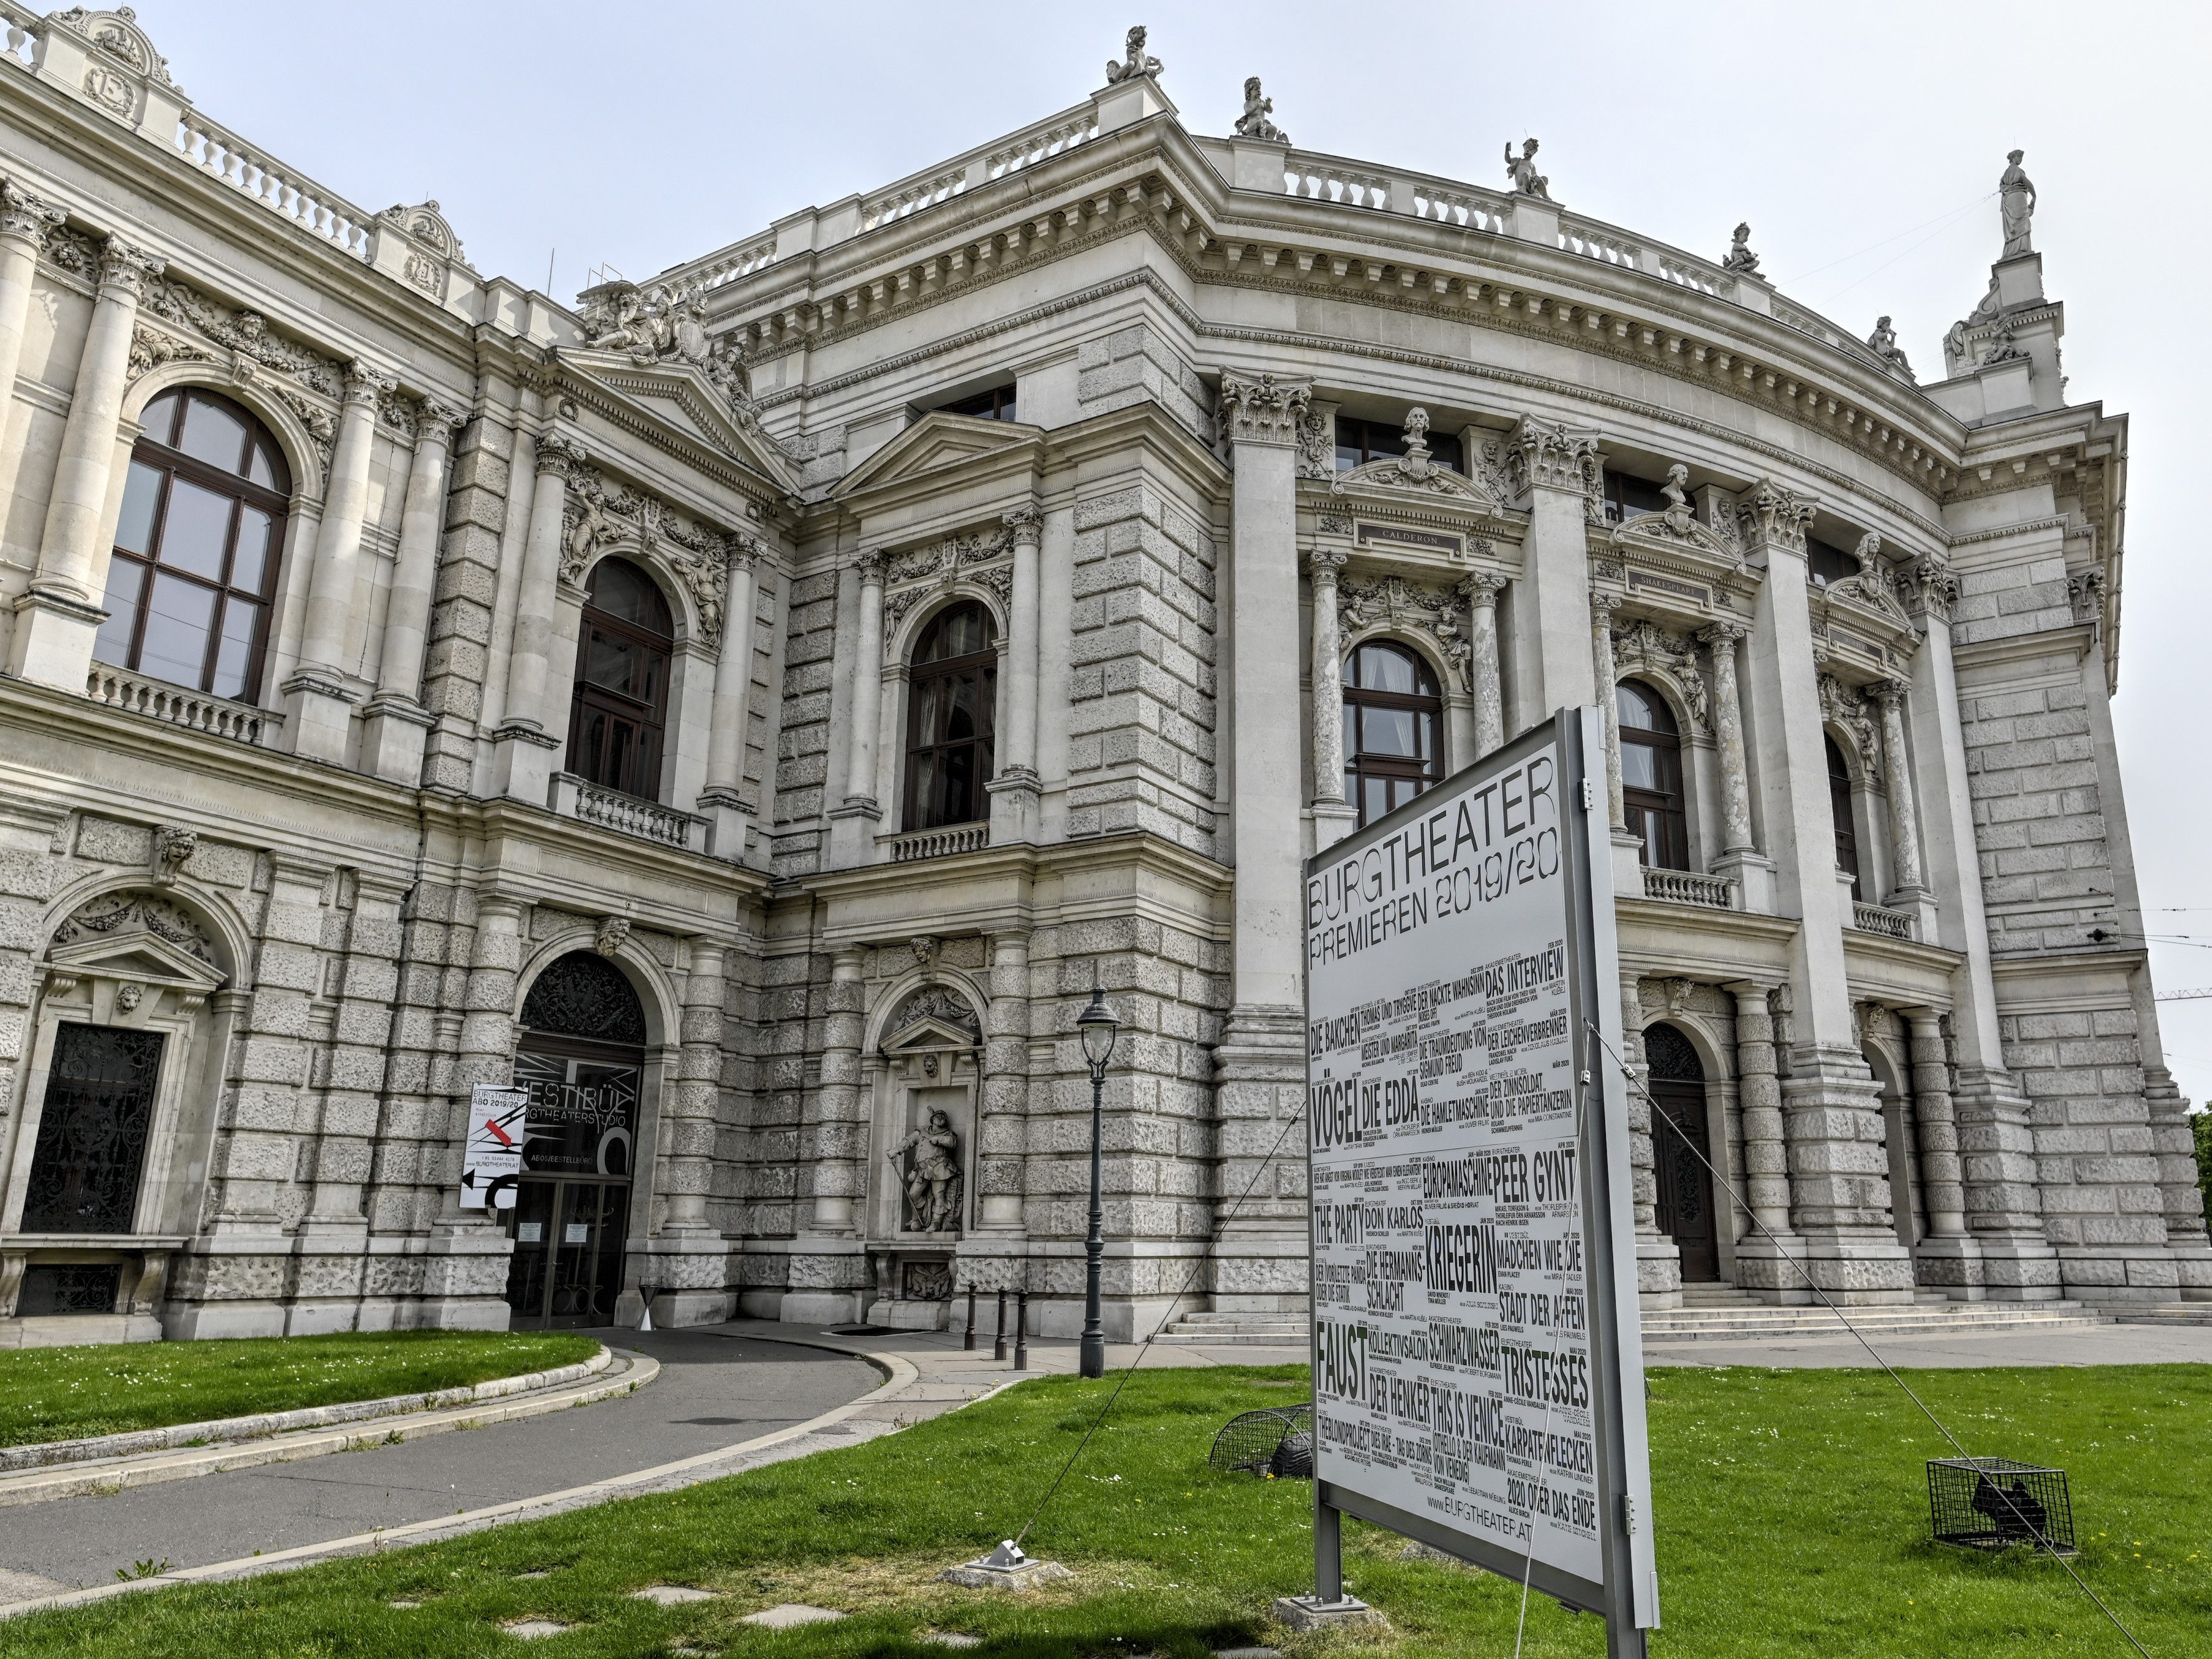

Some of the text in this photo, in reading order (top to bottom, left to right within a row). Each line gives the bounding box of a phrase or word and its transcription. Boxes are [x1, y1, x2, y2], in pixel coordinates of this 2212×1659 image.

[1308, 756, 1555, 930] BURGTHEATER
[1309, 823, 1559, 971] PREMIEREN 2019/20
[1485, 946, 1564, 999] DAS INTERVIEW
[1417, 972, 1484, 1011] DER NACKTE WAHNSINN
[1486, 999, 1495, 1007] NACH
[1519, 989, 1528, 997] THEO
[1486, 1005, 1496, 1013] GOGH
[1512, 996, 1529, 1006] DREHBUCH
[1360, 993, 1417, 1027] THOMAS UND TRYGGVE
[1487, 1006, 1516, 1020] THEODOR HOLMAN
[1558, 1007, 1566, 1015] 2020
[1311, 1011, 1360, 1056] DIE BAKCHEN
[1361, 1040, 1379, 1061] MEISTER
[1380, 1037, 1390, 1056] UND
[1391, 1029, 1418, 1053] MARGARITA
[1419, 1041, 1427, 1060] DIE
[1428, 1029, 1473, 1058] TRAUMDEUTUNG
[1474, 1026, 1486, 1048] VON
[1488, 1015, 1567, 1051] DER LEICHENVERBRENNER
[1420, 1057, 1443, 1080] SIGMUND
[1445, 1052, 1463, 1075] FREUD
[1552, 1060, 1560, 1068] MÄR
[473, 1090, 526, 1101] BURGTHEATER
[524, 1081, 625, 1113] ESTIBÜL
[1362, 1075, 1419, 1129] DIE EDDA
[1489, 1072, 1543, 1100] DER ZINNSOLDAT
[490, 1100, 518, 1108] 2019/20
[1312, 1068, 1362, 1148] VÖGEL
[1421, 1094, 1489, 1126] DIE HAMLETMASCHINE
[1491, 1088, 1572, 1119] UND DIE PAPIERTÄNZERIN
[1423, 1156, 1493, 1199] EUROPAMASCHINE
[1493, 1148, 1577, 1204] PEER GYNT
[1314, 1204, 1364, 1243] THE PARTY
[1365, 1205, 1423, 1229] DON KARLOS
[1366, 1250, 1425, 1282] DIE HERMANNS-
[1425, 1224, 1497, 1295] KRIEGERIN
[1496, 1232, 1581, 1271] MÄDCHEN WIE DIE
[1316, 1262, 1366, 1285] DER (VOR)LETZTE PANDA
[1316, 1283, 1327, 1301] ODER
[1336, 1284, 1350, 1303] STATIK
[1367, 1280, 1404, 1311] SCHLACHT
[1499, 1291, 1585, 1330] STADT DER AFFEN
[1317, 1319, 1369, 1402] FAUST
[1368, 1330, 1428, 1361] KOLLEKTIVSALON
[1428, 1322, 1501, 1371] SCHWARZWASSER
[1501, 1345, 1588, 1409] TRISTESSES
[1370, 1372, 1430, 1424] DER HENKER
[1503, 1394, 1545, 1410] ANNE-CÉCILE VANDALEM
[1318, 1414, 1370, 1453] THEBLONDPROJECT
[1431, 1386, 1504, 1448] THIS IS VENICE
[1371, 1430, 1431, 1465] DIES IRAE TAG DES ZORNS
[1432, 1429, 1505, 1471] (OTHELLO & DER KAUFMANN
[1505, 1424, 1593, 1475] KARPATENFLECKEN
[1582, 1432, 1591, 1440] 2020
[1433, 1452, 1469, 1486] VON VENEDIG)
[1507, 1476, 1526, 1508] 2020
[1552, 1489, 1569, 1523] DAS
[1572, 1495, 1596, 1531] ENDE
[1576, 1488, 1594, 1500] JUN 2020
[1427, 1491, 1532, 1543] www.BURGTHEATER.AT
[1508, 1506, 1529, 1518] ALICE BIRCH
